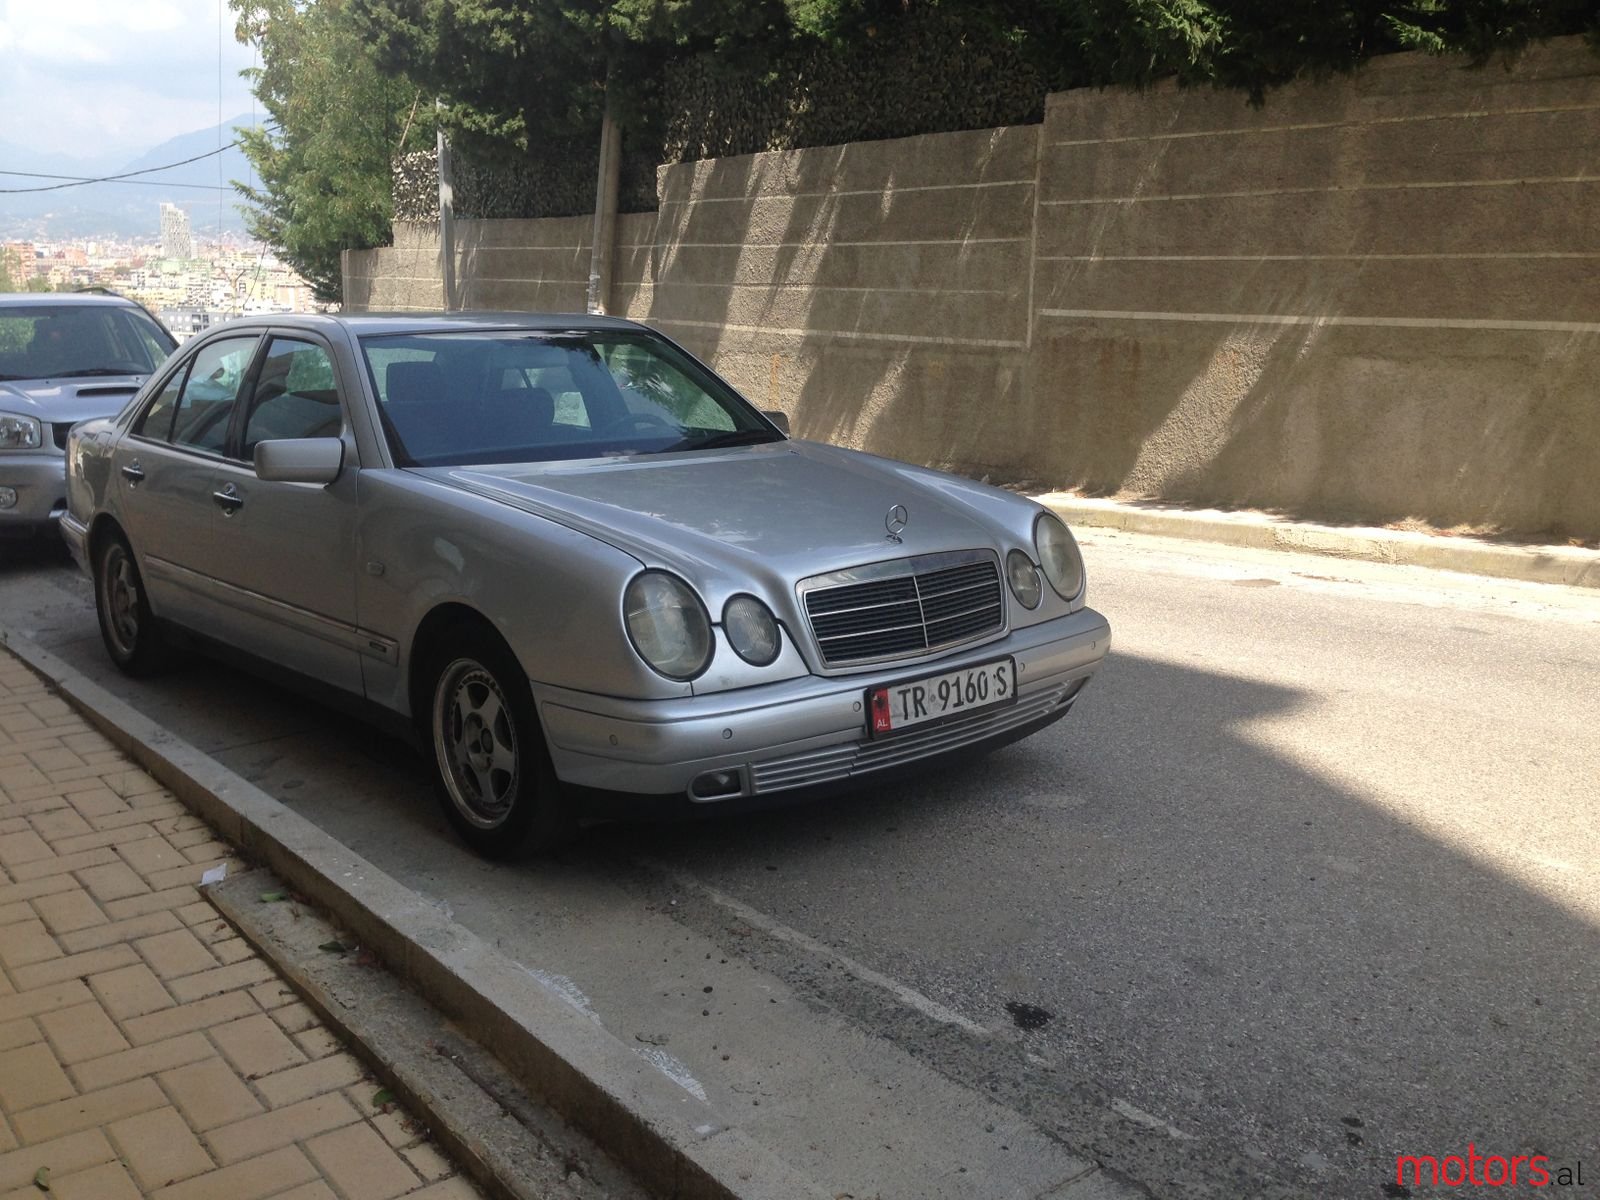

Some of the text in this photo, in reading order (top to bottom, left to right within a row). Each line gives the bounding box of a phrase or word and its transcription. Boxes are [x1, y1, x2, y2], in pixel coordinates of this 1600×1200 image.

[897, 666, 1007, 720] TR 9160 S
[876, 718, 888, 729] AL
